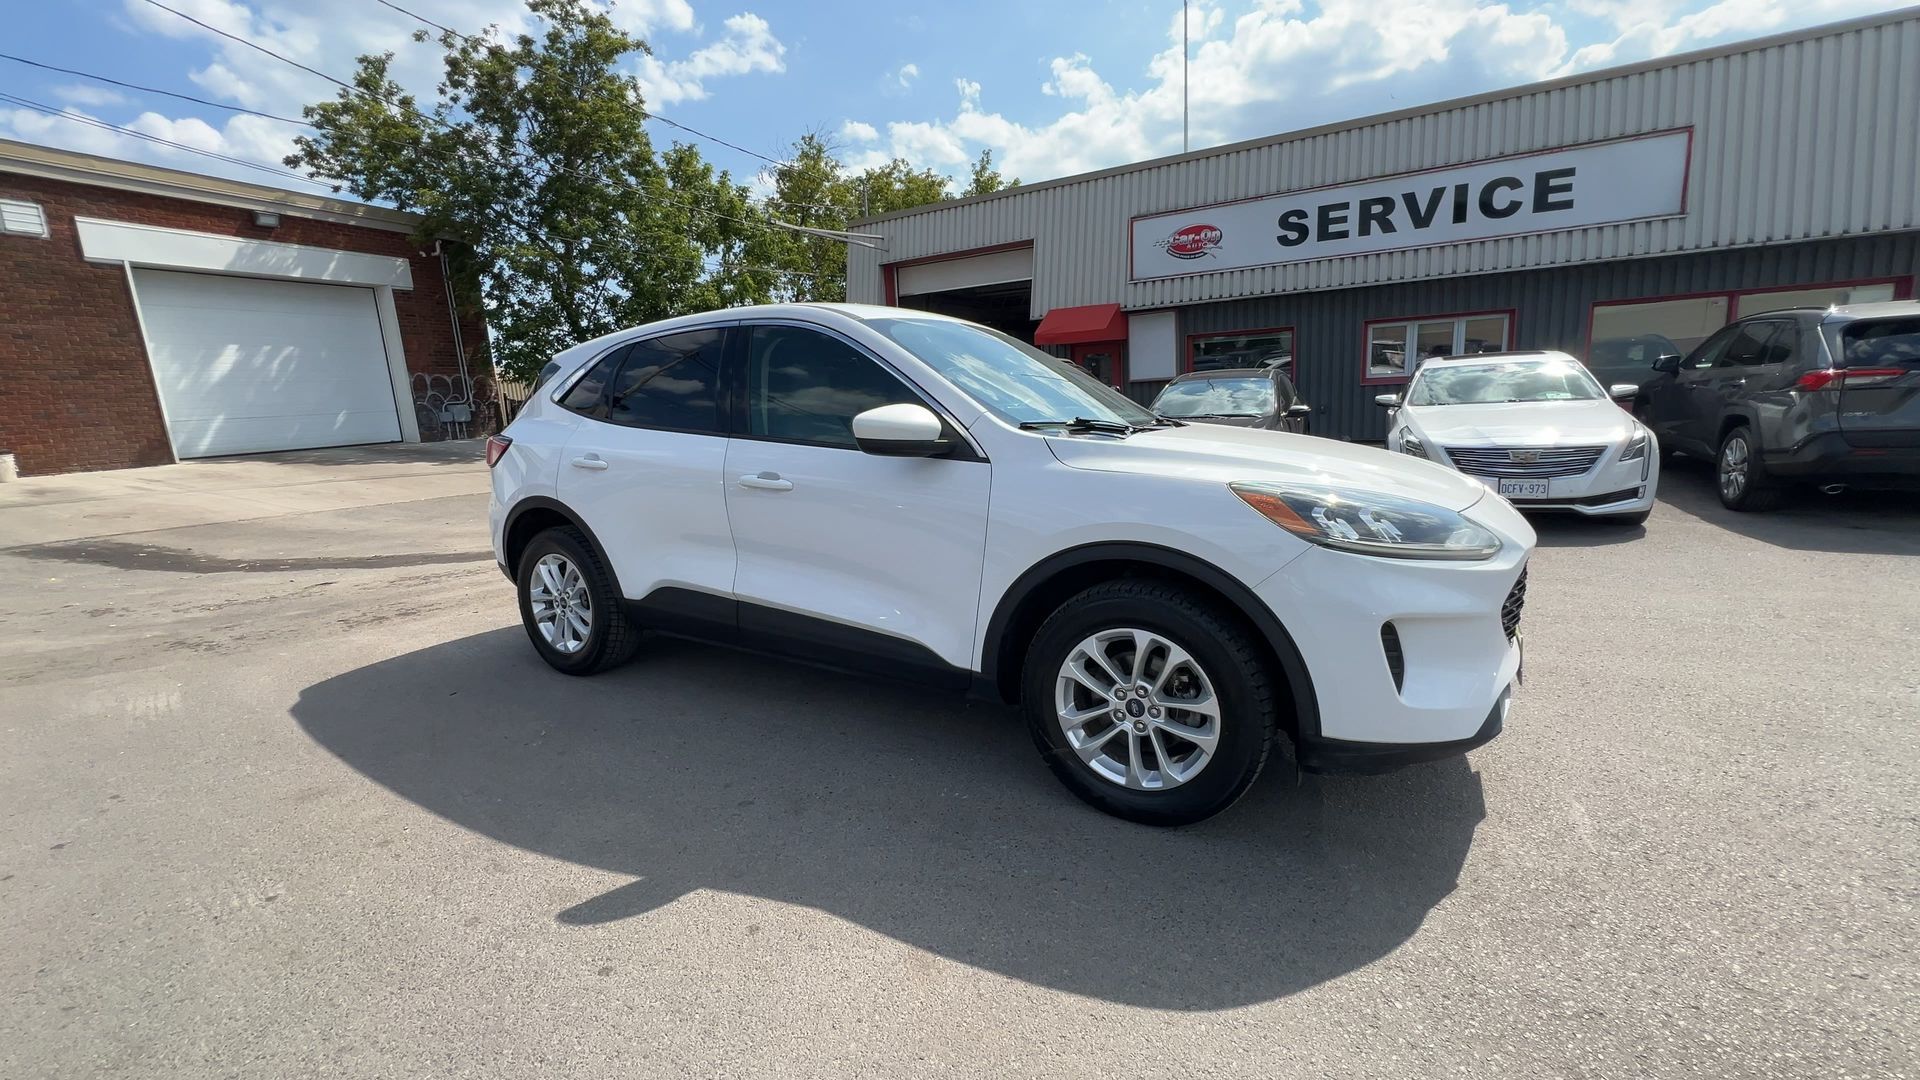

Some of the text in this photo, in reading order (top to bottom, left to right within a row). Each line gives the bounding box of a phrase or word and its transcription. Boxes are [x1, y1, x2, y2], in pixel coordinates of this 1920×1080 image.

[1276, 167, 1576, 247] SERVICE
[1171, 229, 1221, 246] Car-On
[1186, 241, 1209, 250] AUTO
